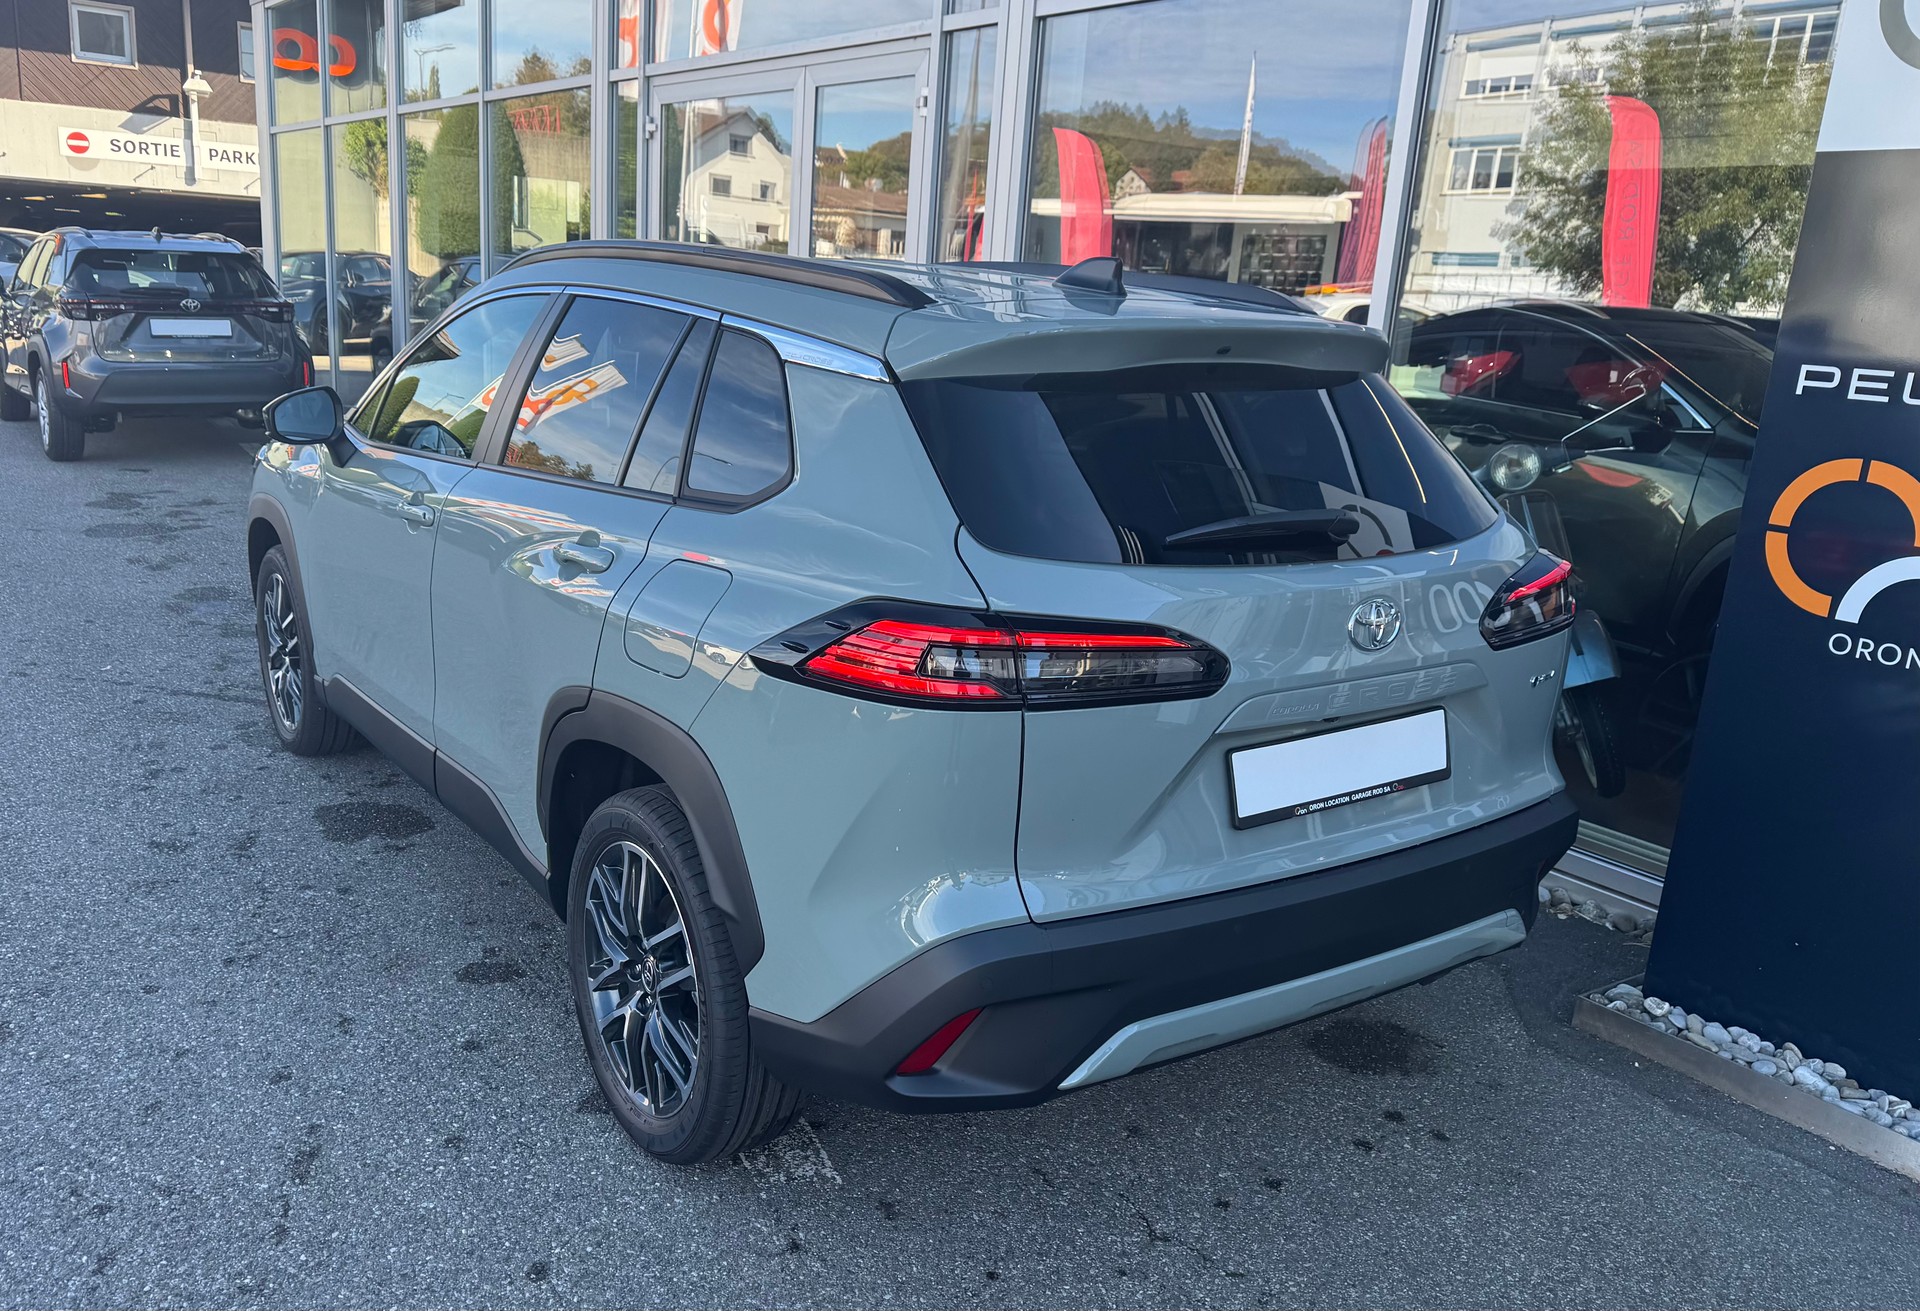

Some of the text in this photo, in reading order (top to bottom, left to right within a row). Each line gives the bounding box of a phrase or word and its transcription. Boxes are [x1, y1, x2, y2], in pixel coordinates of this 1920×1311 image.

[110, 138, 181, 158] SORTIE
[1828, 633, 1920, 669] ORON
[1309, 801, 1325, 811] ORON
[1325, 795, 1350, 807] LOCATION
[1351, 790, 1372, 801] GARAGE
[1372, 787, 1384, 796] ROD
